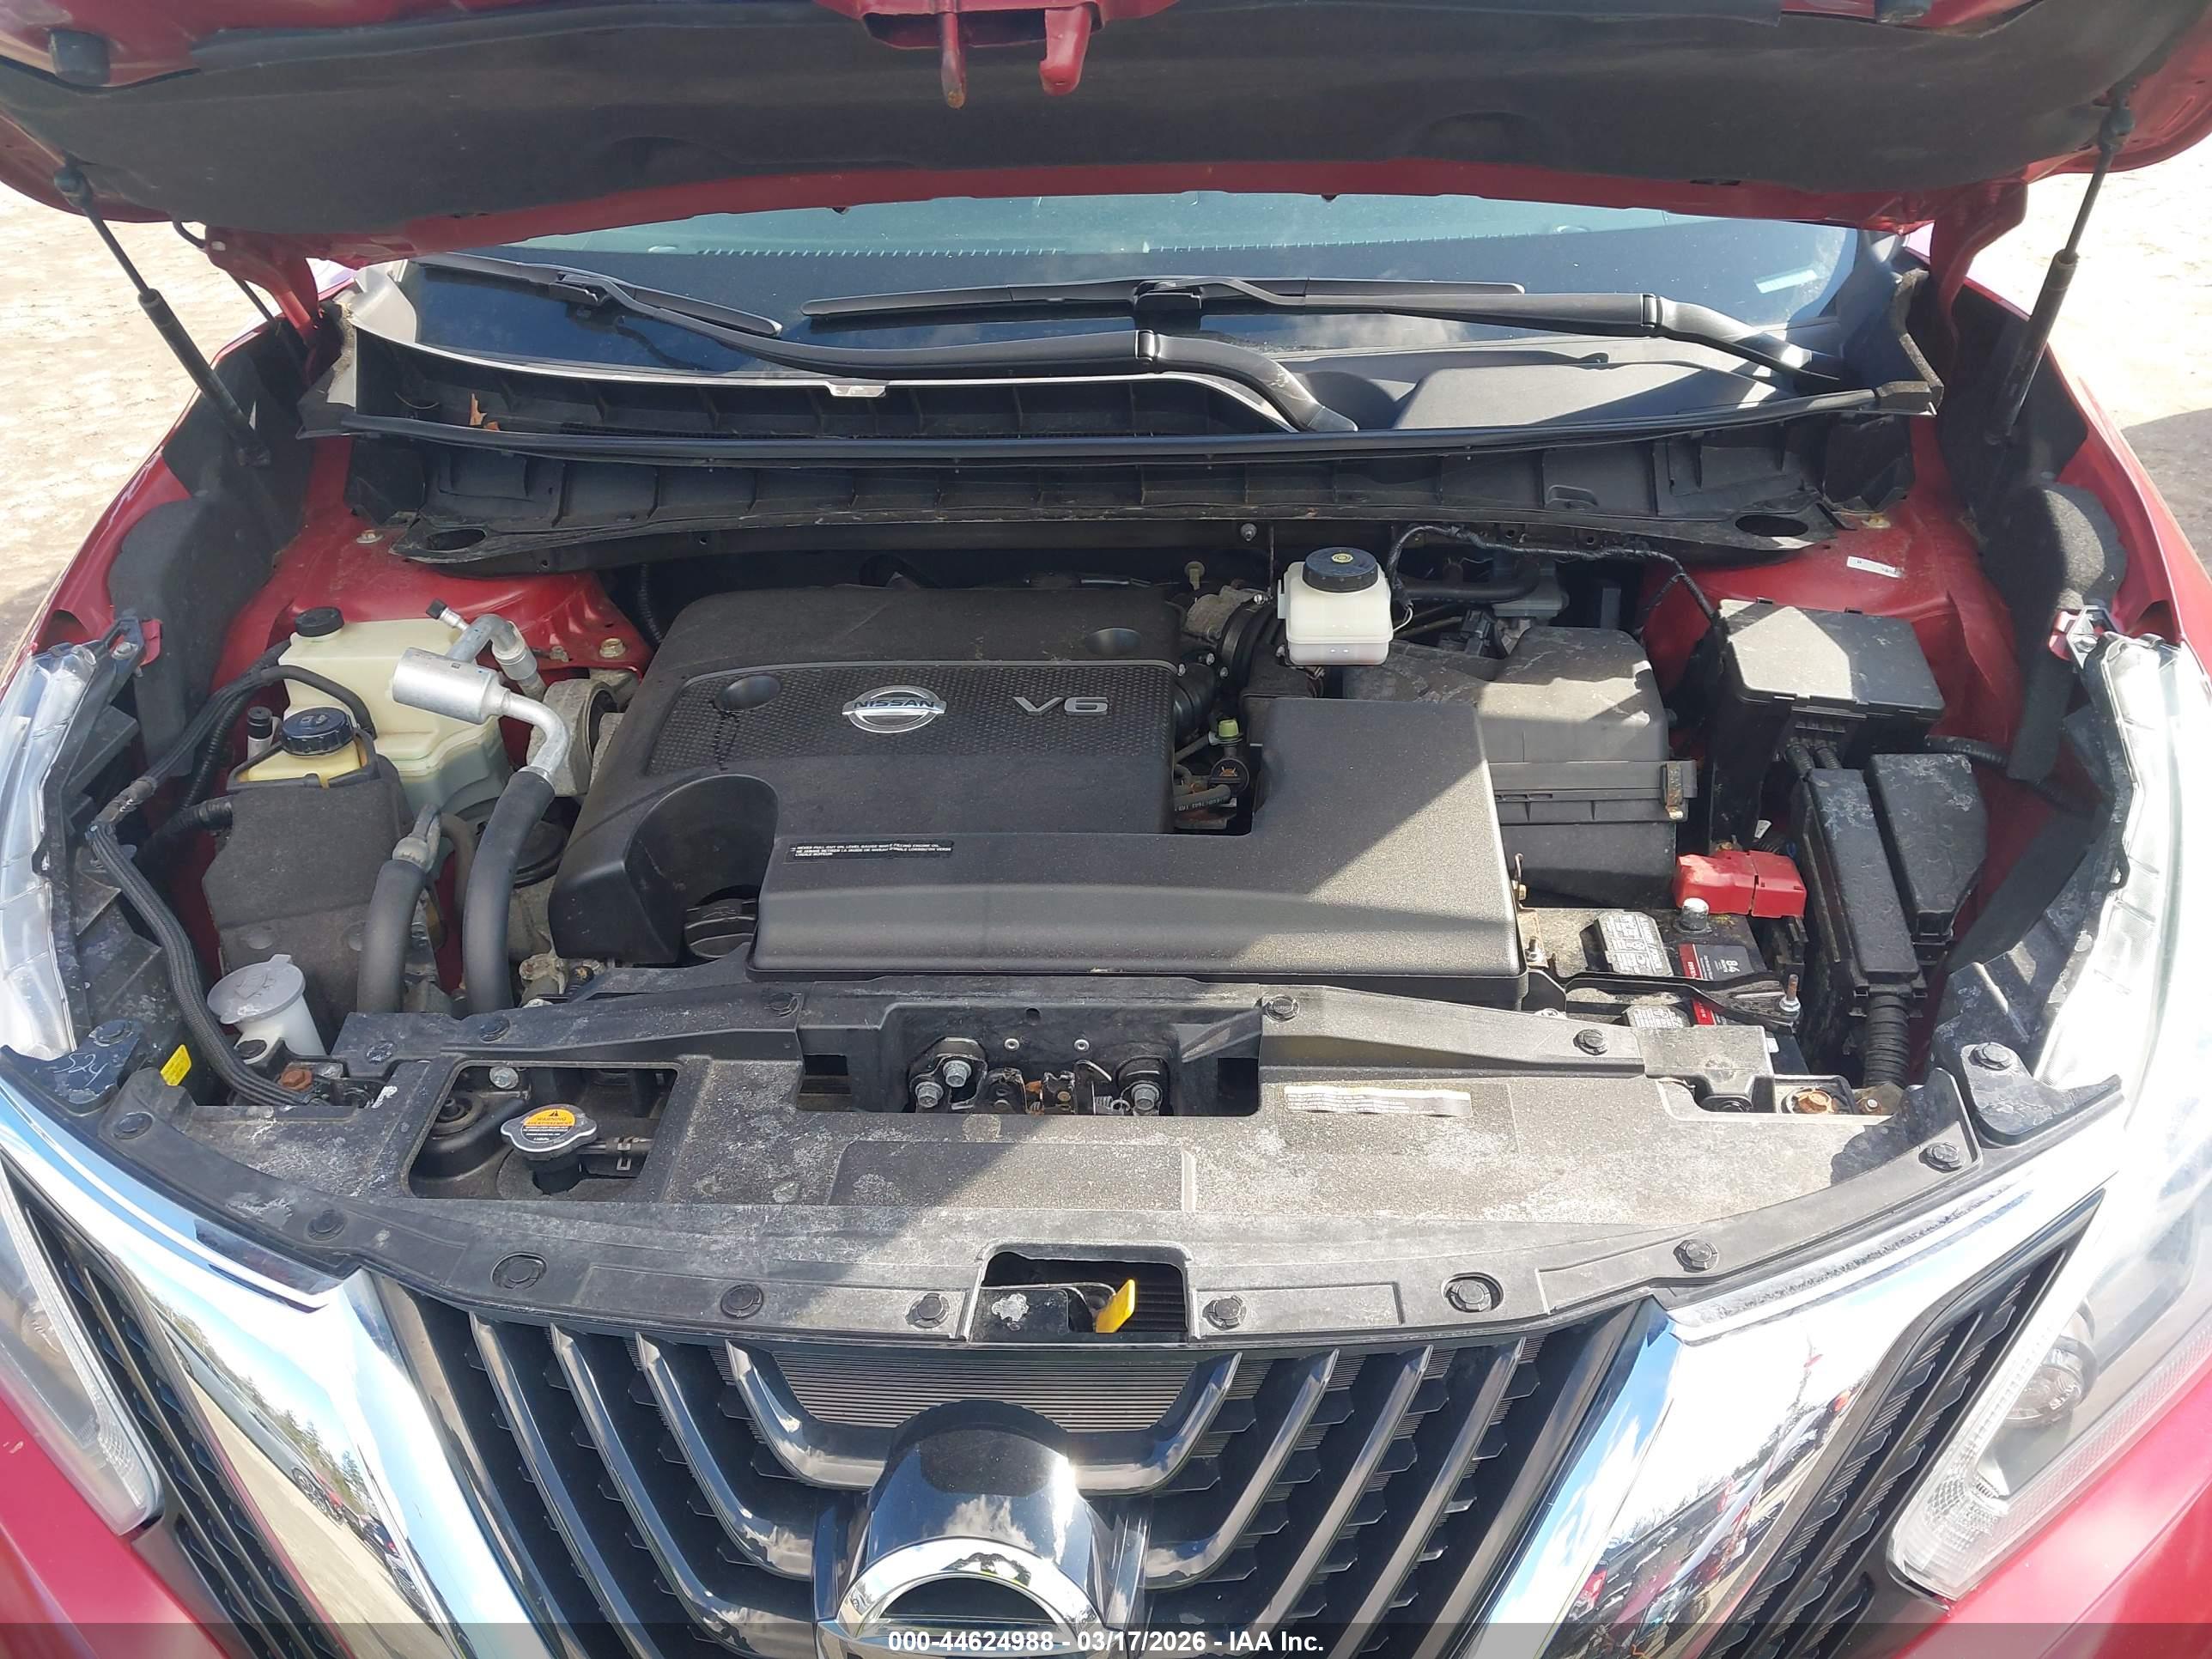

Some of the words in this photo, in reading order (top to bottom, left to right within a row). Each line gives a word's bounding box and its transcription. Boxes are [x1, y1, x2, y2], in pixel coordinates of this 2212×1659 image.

[854, 699, 934, 708] NISSAN
[1013, 696, 1109, 716] V6
[1726, 959, 1741, 973] 84
